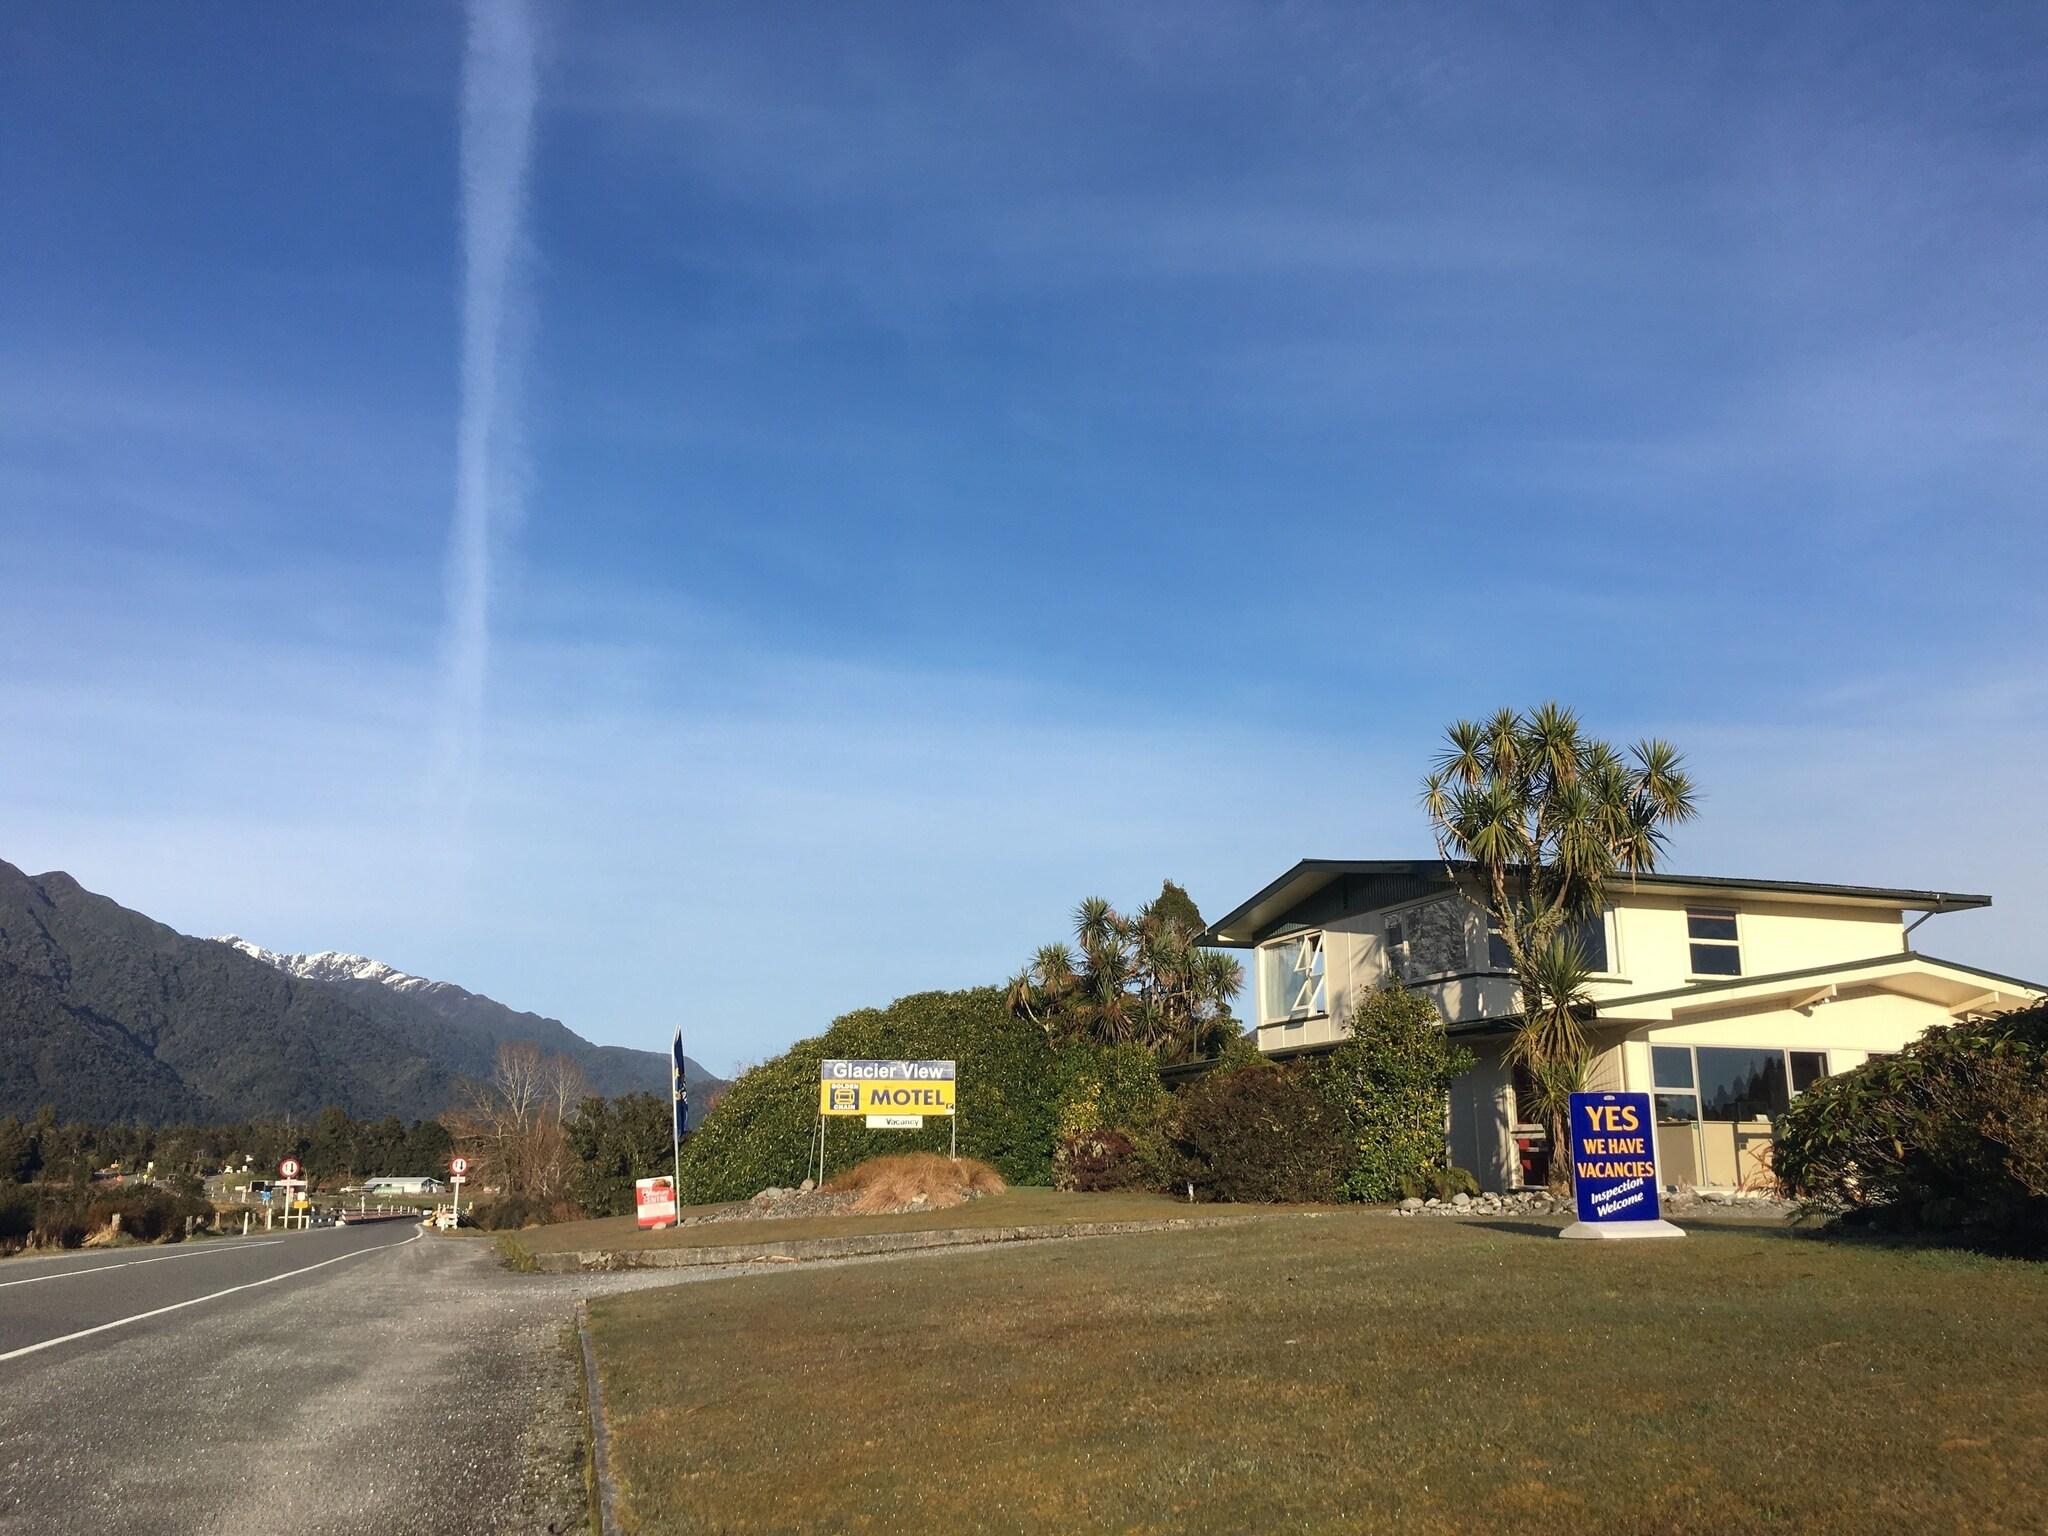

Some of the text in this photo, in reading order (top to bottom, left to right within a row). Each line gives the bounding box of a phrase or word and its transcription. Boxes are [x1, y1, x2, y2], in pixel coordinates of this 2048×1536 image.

[833, 1063, 943, 1078] Glacier View
[870, 1089, 945, 1105] MOTEL
[886, 1118, 919, 1126] Vacancy
[1585, 1106, 1639, 1131] YES
[1583, 1138, 1645, 1154] WE HAVE
[1577, 1162, 1654, 1178] VACANCIES
[1591, 1178, 1644, 1204] Inspection
[1597, 1192, 1644, 1217] Welcome
